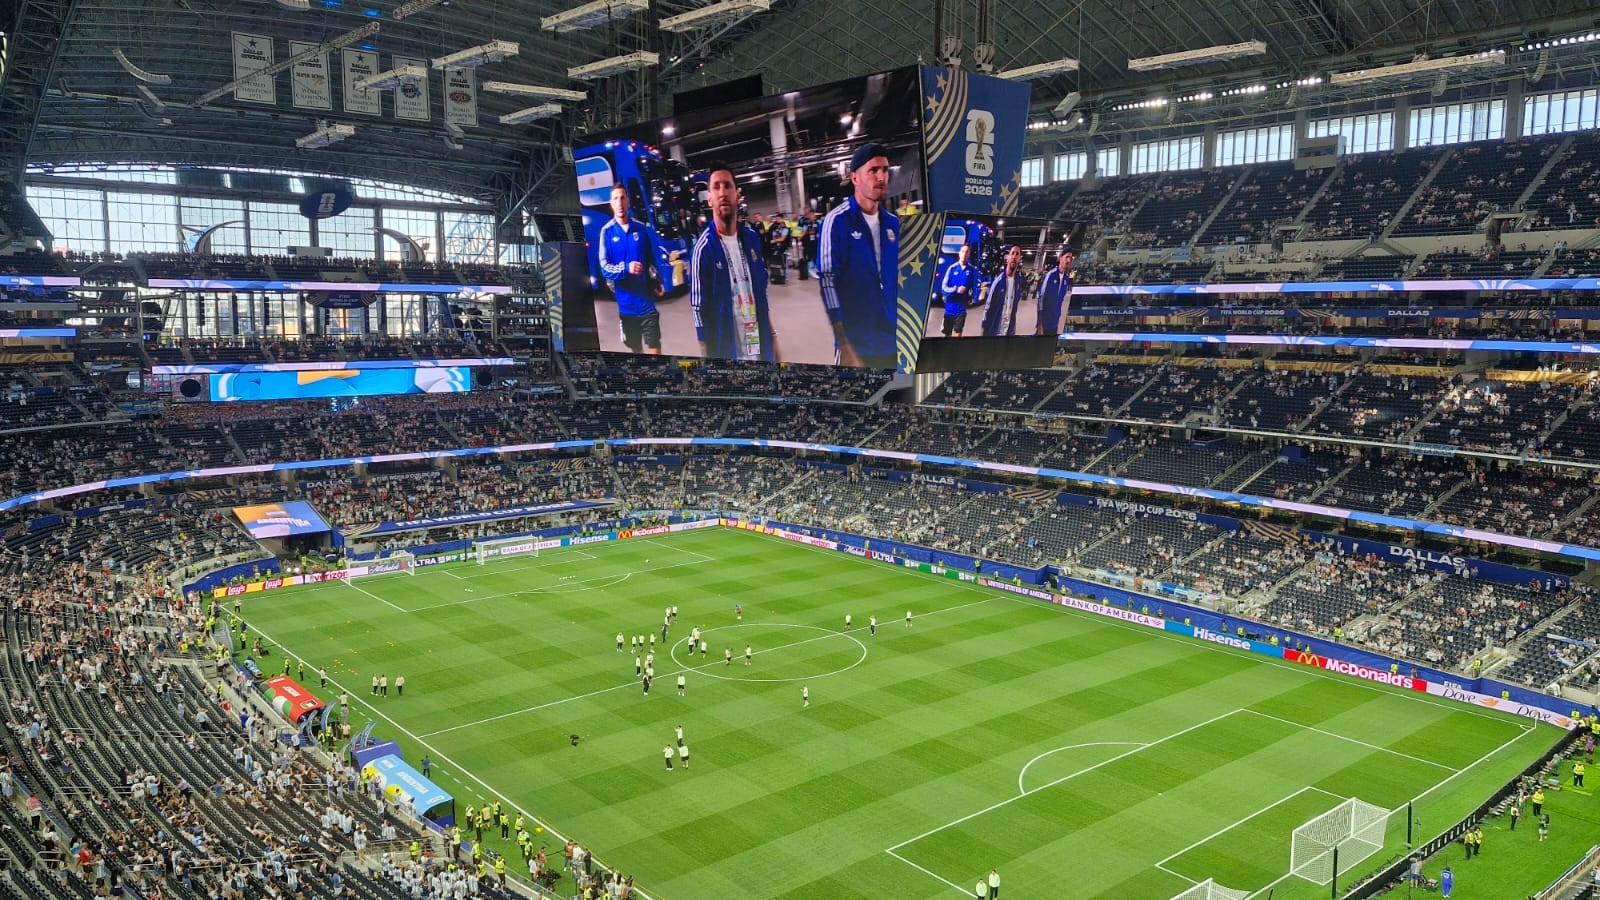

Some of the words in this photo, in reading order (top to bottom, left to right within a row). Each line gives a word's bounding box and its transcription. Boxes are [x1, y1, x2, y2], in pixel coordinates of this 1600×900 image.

[973, 162, 986, 170] FIFA
[965, 177, 982, 185] WORLD
[964, 184, 993, 196] 2026
[307, 479, 352, 488] DALLAS
[911, 473, 955, 485] DALLAS
[1115, 500, 1145, 512] WORLD
[1146, 505, 1164, 515] CUP
[395, 518, 433, 527] FIFA
[433, 510, 491, 523] WORLD
[492, 507, 523, 516] CUP
[631, 525, 670, 537] McDonald's
[569, 533, 609, 545] Hisense
[407, 557, 436, 568] ULTRA
[871, 550, 895, 564] ULTRA
[1389, 545, 1466, 567] DALLAS
[1004, 583, 1022, 593] STATES
[1022, 587, 1029, 595] OF
[1029, 589, 1052, 601] AMERICA
[1065, 598, 1090, 611] BANK
[1092, 604, 1105, 613] OF
[1106, 607, 1150, 625] AMERICA
[1193, 626, 1251, 650] Hisense
[1325, 658, 1413, 689] McDonald's
[1442, 687, 1476, 703] Dove
[1516, 703, 1552, 721] Dove
